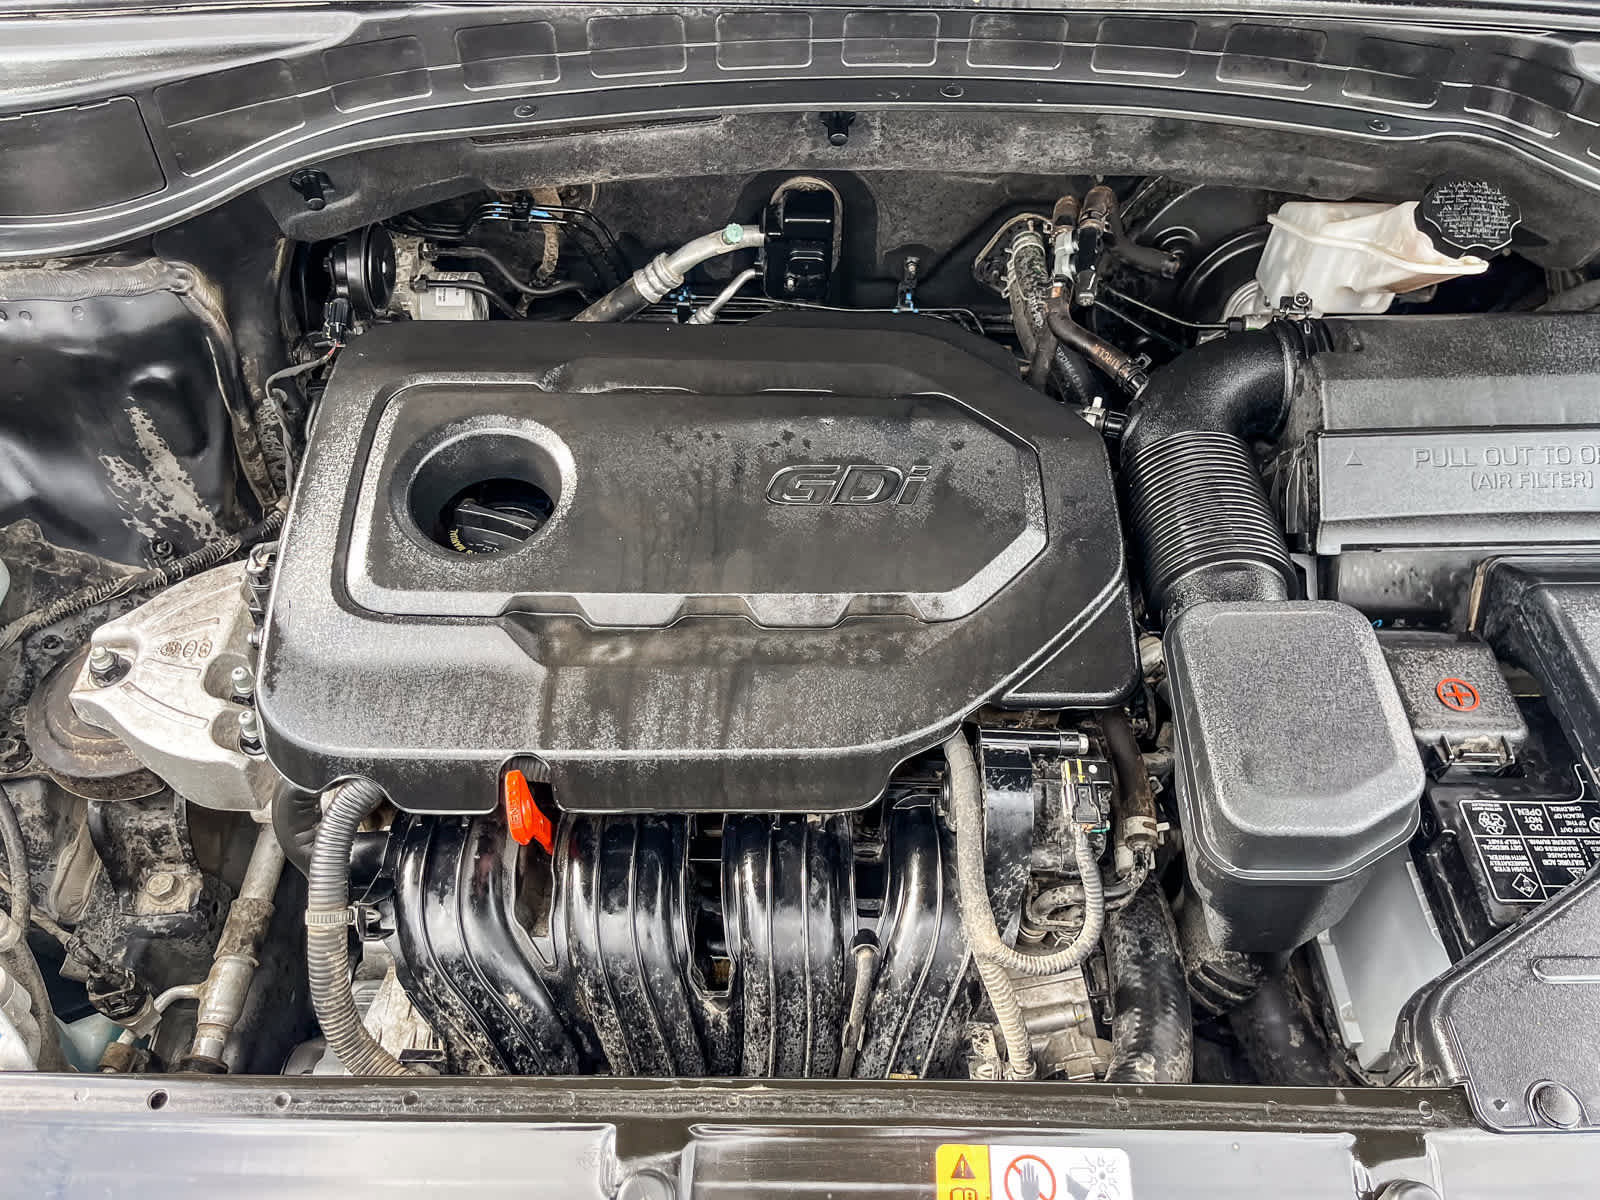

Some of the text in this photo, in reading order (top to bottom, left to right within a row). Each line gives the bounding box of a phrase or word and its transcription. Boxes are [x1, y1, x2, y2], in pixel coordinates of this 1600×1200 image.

[1413, 447, 1478, 469] PULL
[1483, 445, 1533, 467] OUT
[1540, 445, 1572, 465] TO
[766, 464, 932, 506] GDi
[1470, 470, 1594, 492] (AIR FILTER)
[1514, 808, 1543, 816] OPEN.
[1524, 816, 1543, 824] NOT
[1529, 823, 1544, 831] DO
